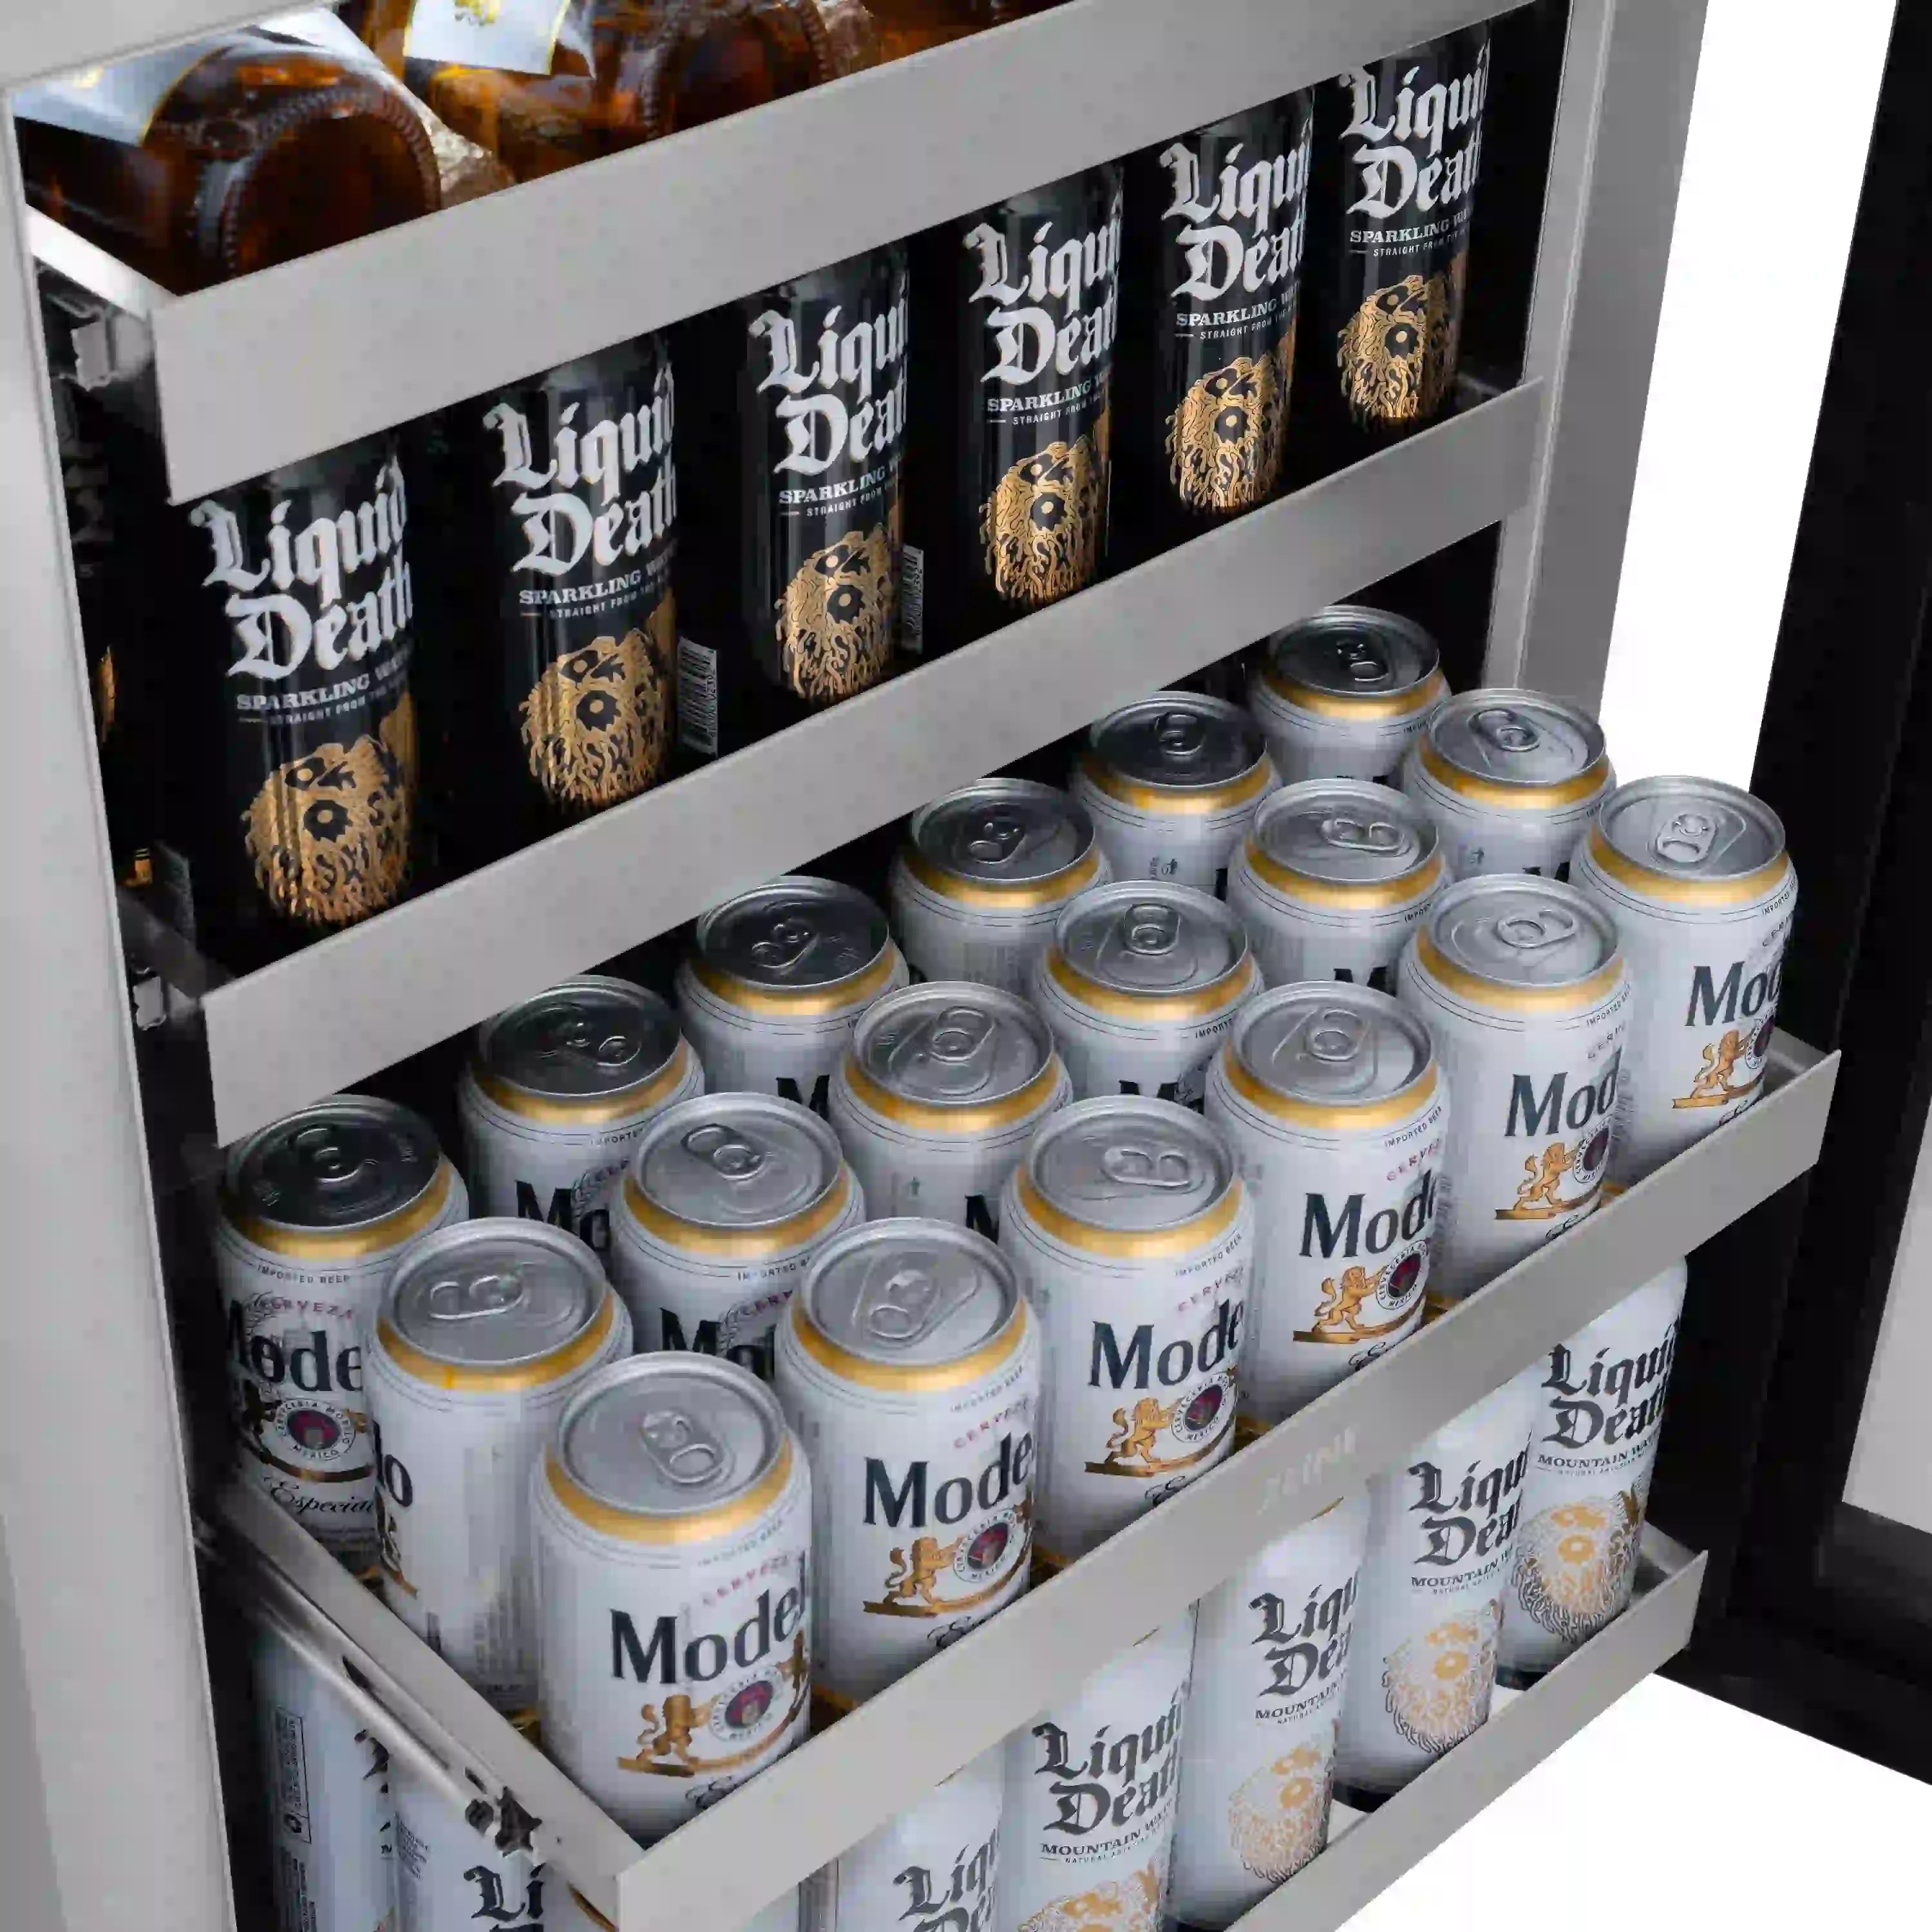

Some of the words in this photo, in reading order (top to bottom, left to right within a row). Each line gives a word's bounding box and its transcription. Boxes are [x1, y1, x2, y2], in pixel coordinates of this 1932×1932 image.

[1350, 219, 1449, 243] SPARKLING
[1177, 298, 1277, 327] SPARKLING
[987, 378, 1092, 412] SPARKLING
[483, 362, 675, 506] Liquid
[779, 466, 886, 504] SPARKLING
[511, 443, 677, 576] Death
[188, 455, 408, 609] Liquid
[519, 569, 641, 605] SPARKLING
[225, 546, 413, 680] Death
[236, 674, 370, 710] SPARKLING
[1537, 1453, 1628, 1468] MOUNTAIN
[1412, 1558, 1499, 1587] MOUNTAIN
[1042, 1829, 1141, 1856] MOUNTAIN
